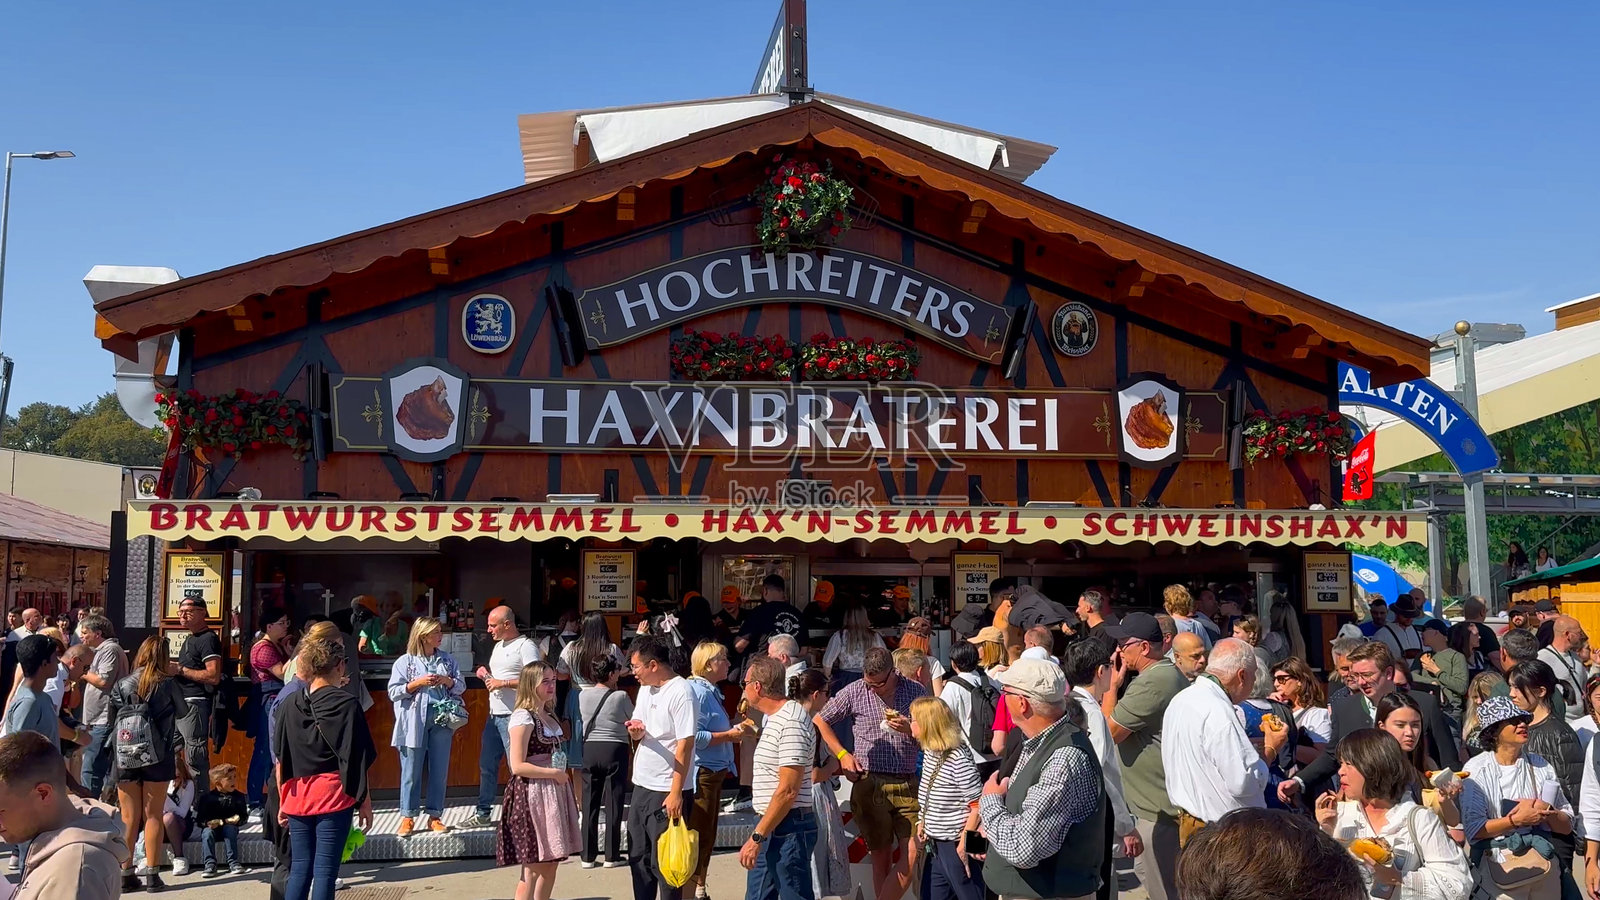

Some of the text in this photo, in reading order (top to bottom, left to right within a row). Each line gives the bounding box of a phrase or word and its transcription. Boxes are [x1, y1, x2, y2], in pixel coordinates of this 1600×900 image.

[614, 252, 976, 338] HOCHREITERS
[528, 388, 1059, 451] HAXNBRATEREI
[147, 503, 1408, 539] BRATWURSTSEMMEL HAX'N-SEMMEL SCHWEINSHAX'N
